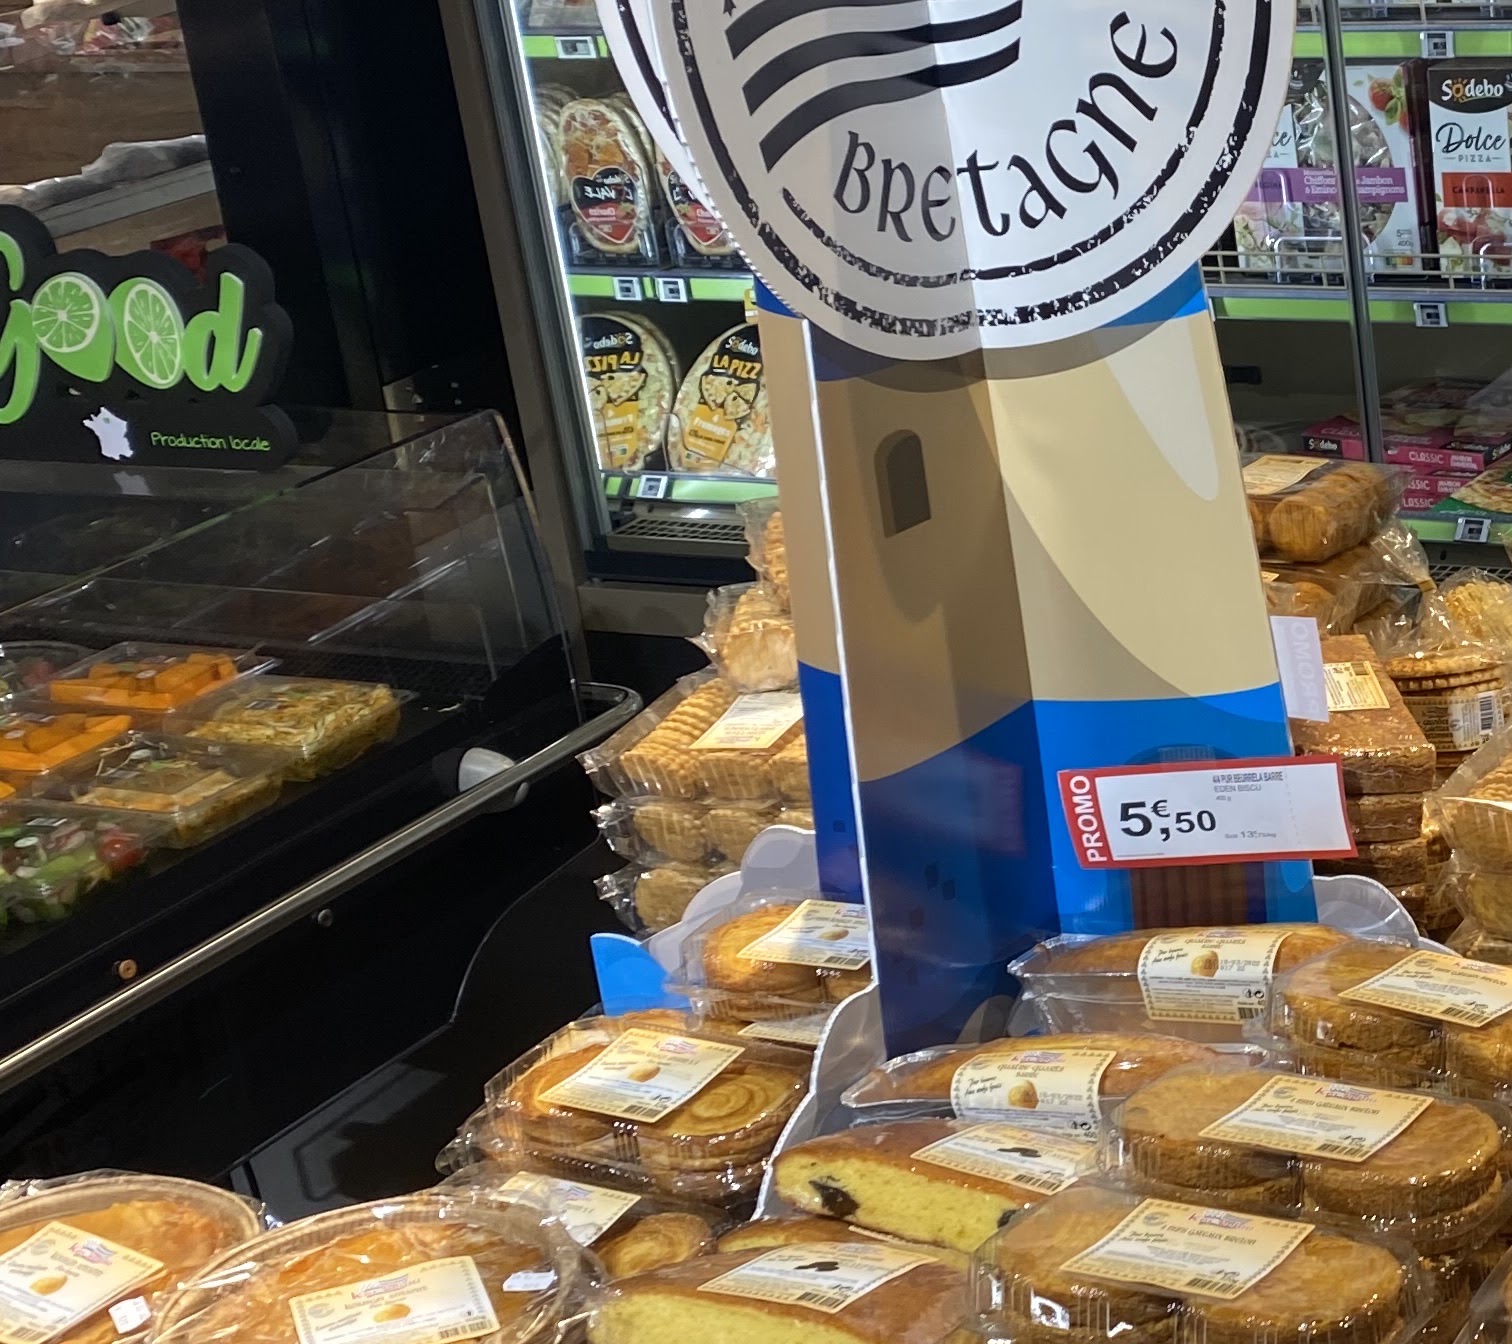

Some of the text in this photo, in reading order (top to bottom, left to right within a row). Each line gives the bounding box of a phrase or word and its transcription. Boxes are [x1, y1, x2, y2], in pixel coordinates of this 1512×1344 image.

[1434, 121, 1506, 158] Dolce
[1457, 153, 1493, 164] PIZZA
[150, 431, 271, 452] Production locale
[1069, 774, 1108, 864] PROMO
